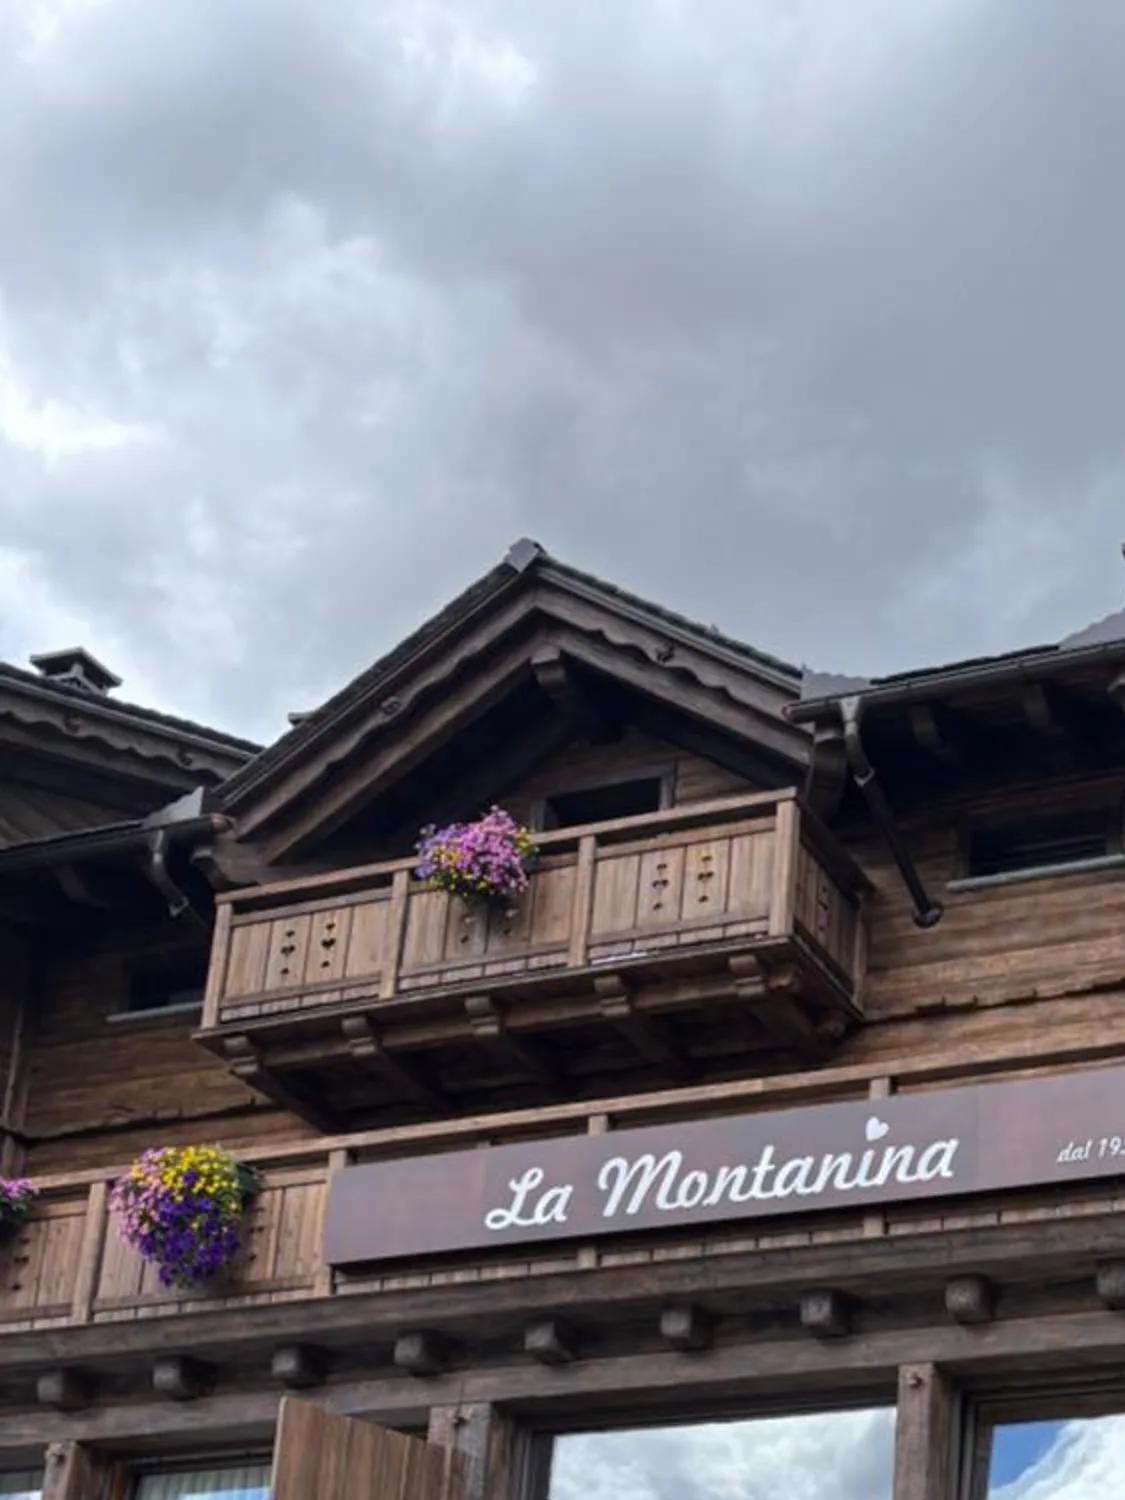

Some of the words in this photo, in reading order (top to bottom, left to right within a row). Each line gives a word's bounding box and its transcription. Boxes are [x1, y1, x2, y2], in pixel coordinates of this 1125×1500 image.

[484, 1166, 573, 1230] La
[598, 1116, 960, 1217] Montanina
[1057, 1139, 1093, 1163] dal
